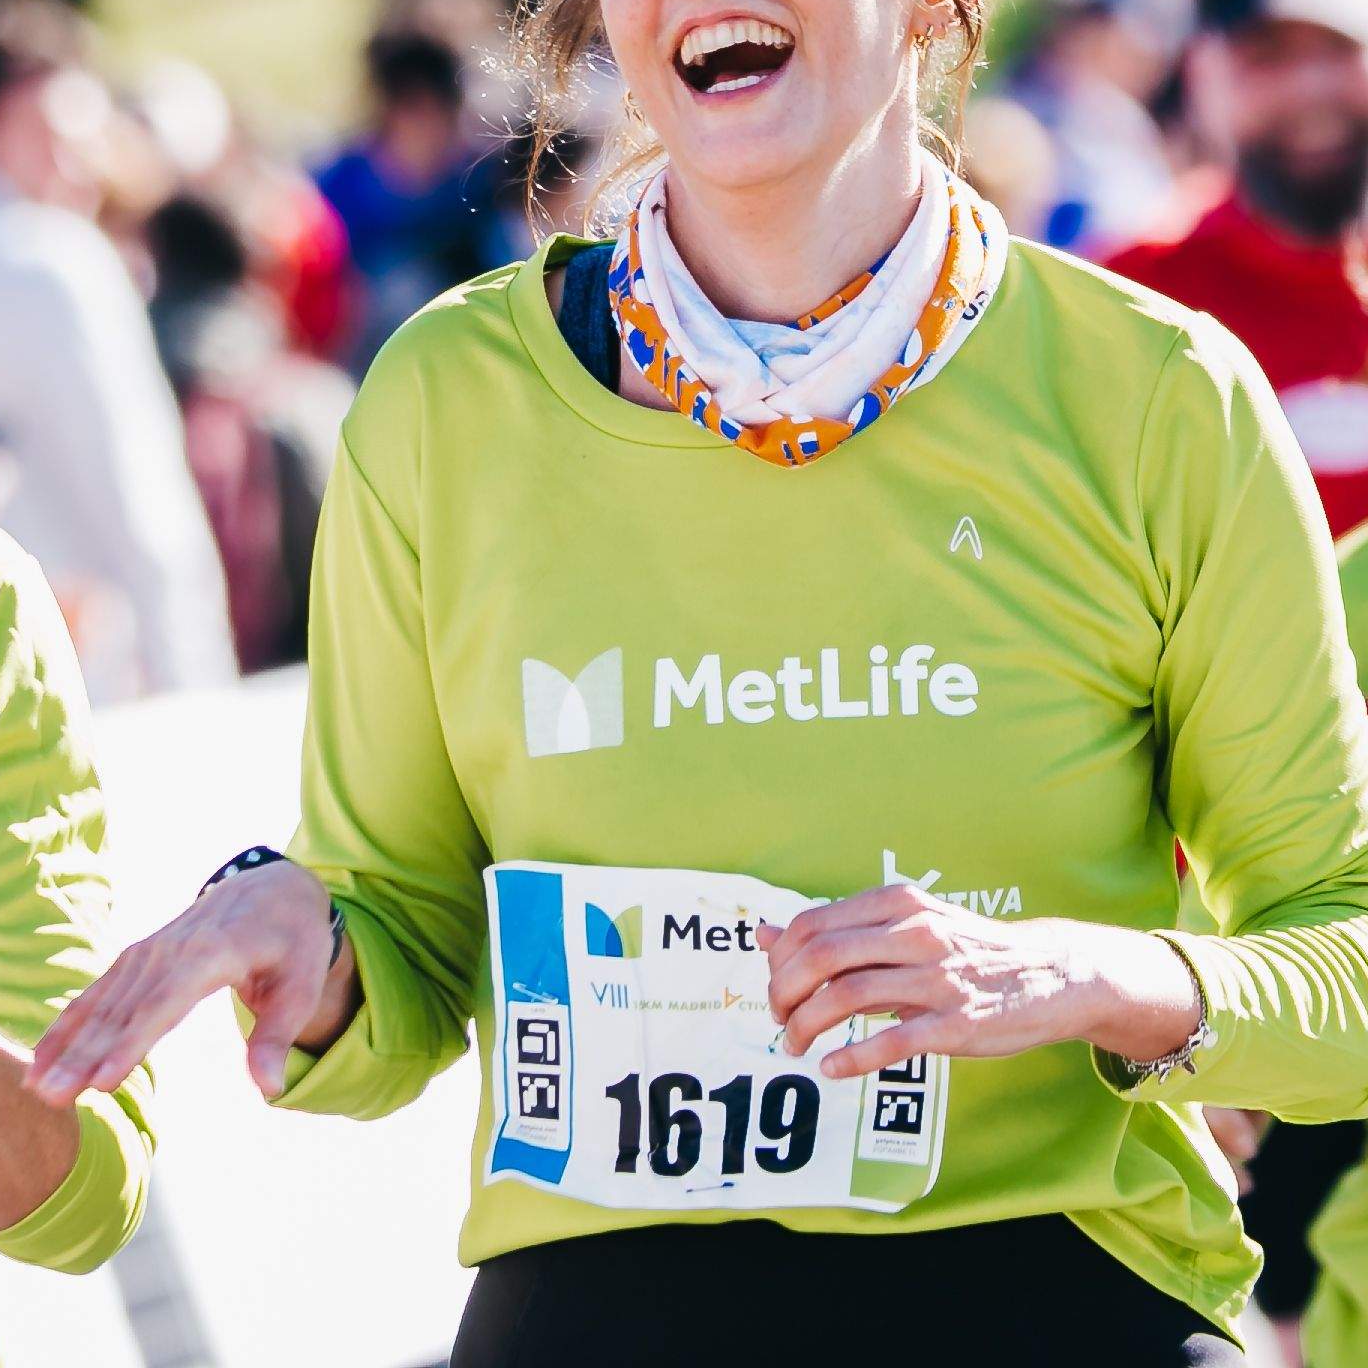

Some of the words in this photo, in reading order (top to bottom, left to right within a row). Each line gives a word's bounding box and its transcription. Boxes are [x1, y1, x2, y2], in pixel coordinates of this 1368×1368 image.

[653, 645, 979, 728] MetLife
[590, 982, 629, 1009] VIII
[668, 1001, 722, 1011] MADRID
[606, 1073, 820, 1175] 1619
